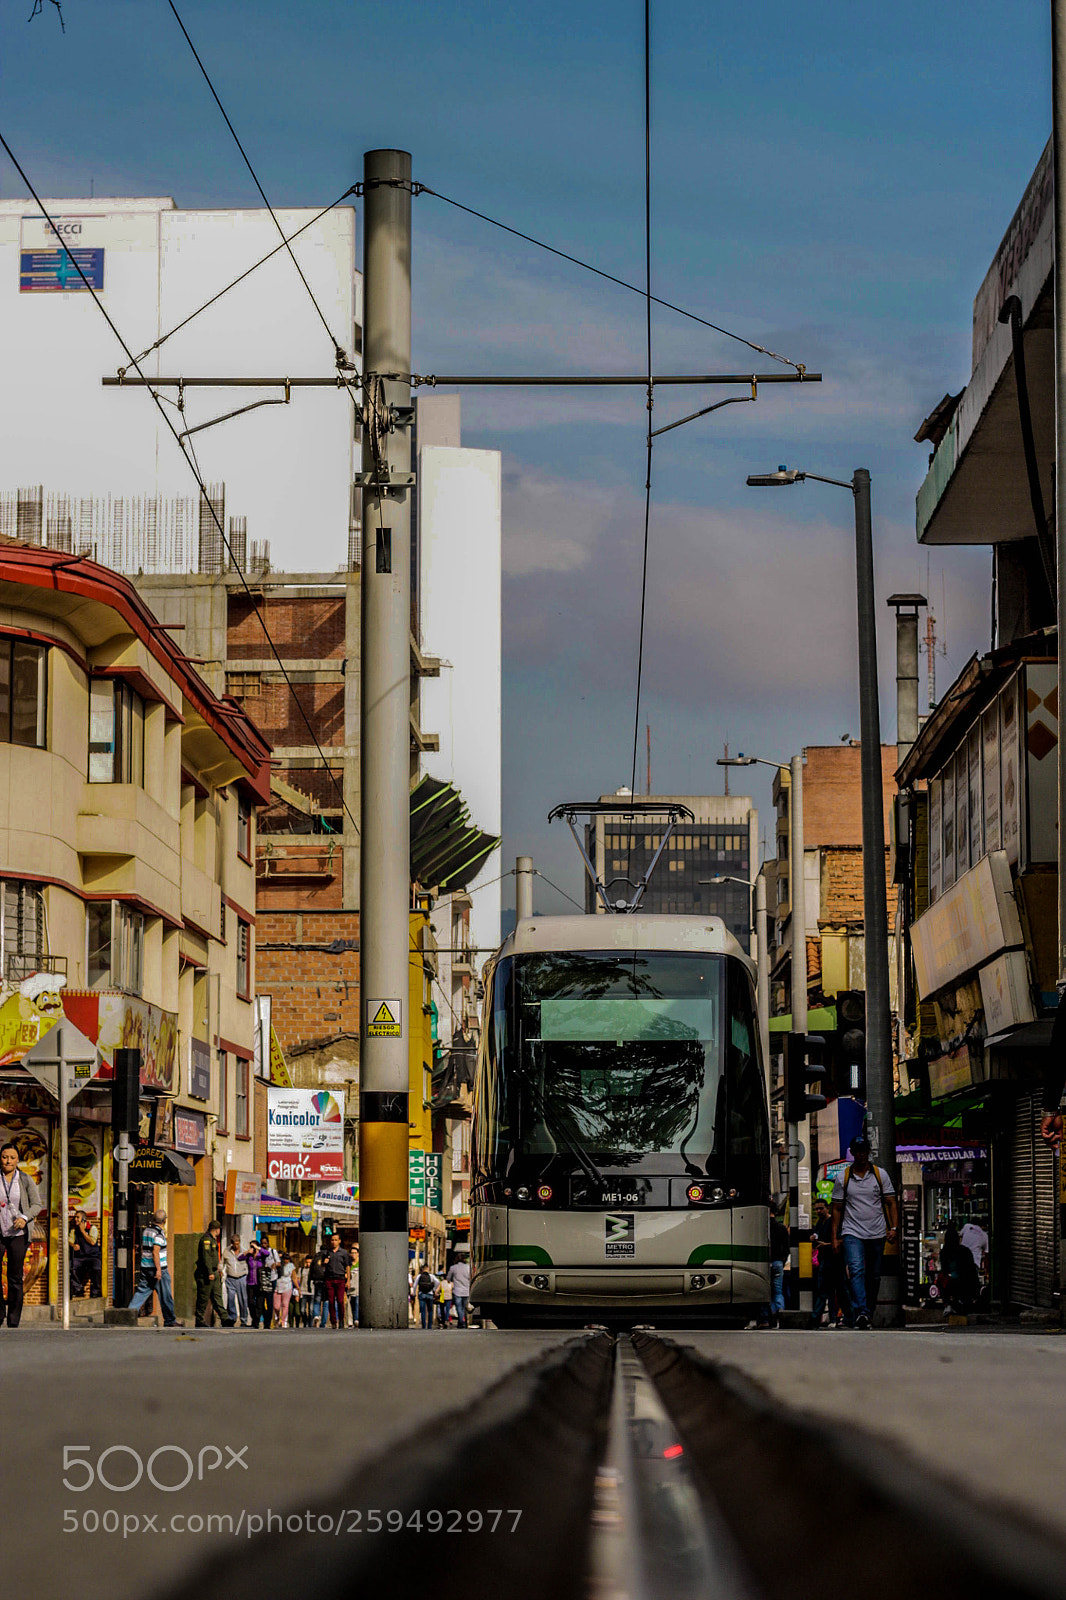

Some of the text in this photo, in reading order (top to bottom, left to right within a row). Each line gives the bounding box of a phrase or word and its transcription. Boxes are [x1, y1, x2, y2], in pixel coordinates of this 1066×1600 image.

[57, 224, 82, 234] ECCI
[269, 1109, 320, 1126] Konicolor
[134, 1148, 165, 1162] CORERA
[916, 1152, 937, 1162] PARA
[937, 1150, 975, 1161] CELULAR
[129, 1160, 162, 1168] JAIME
[268, 1156, 308, 1179] Claro
[409, 1156, 425, 1205] HOTEL
[425, 1155, 438, 1209] HOTEL
[318, 1190, 352, 1202] Konicolor
[602, 1193, 638, 1202] ME1-06
